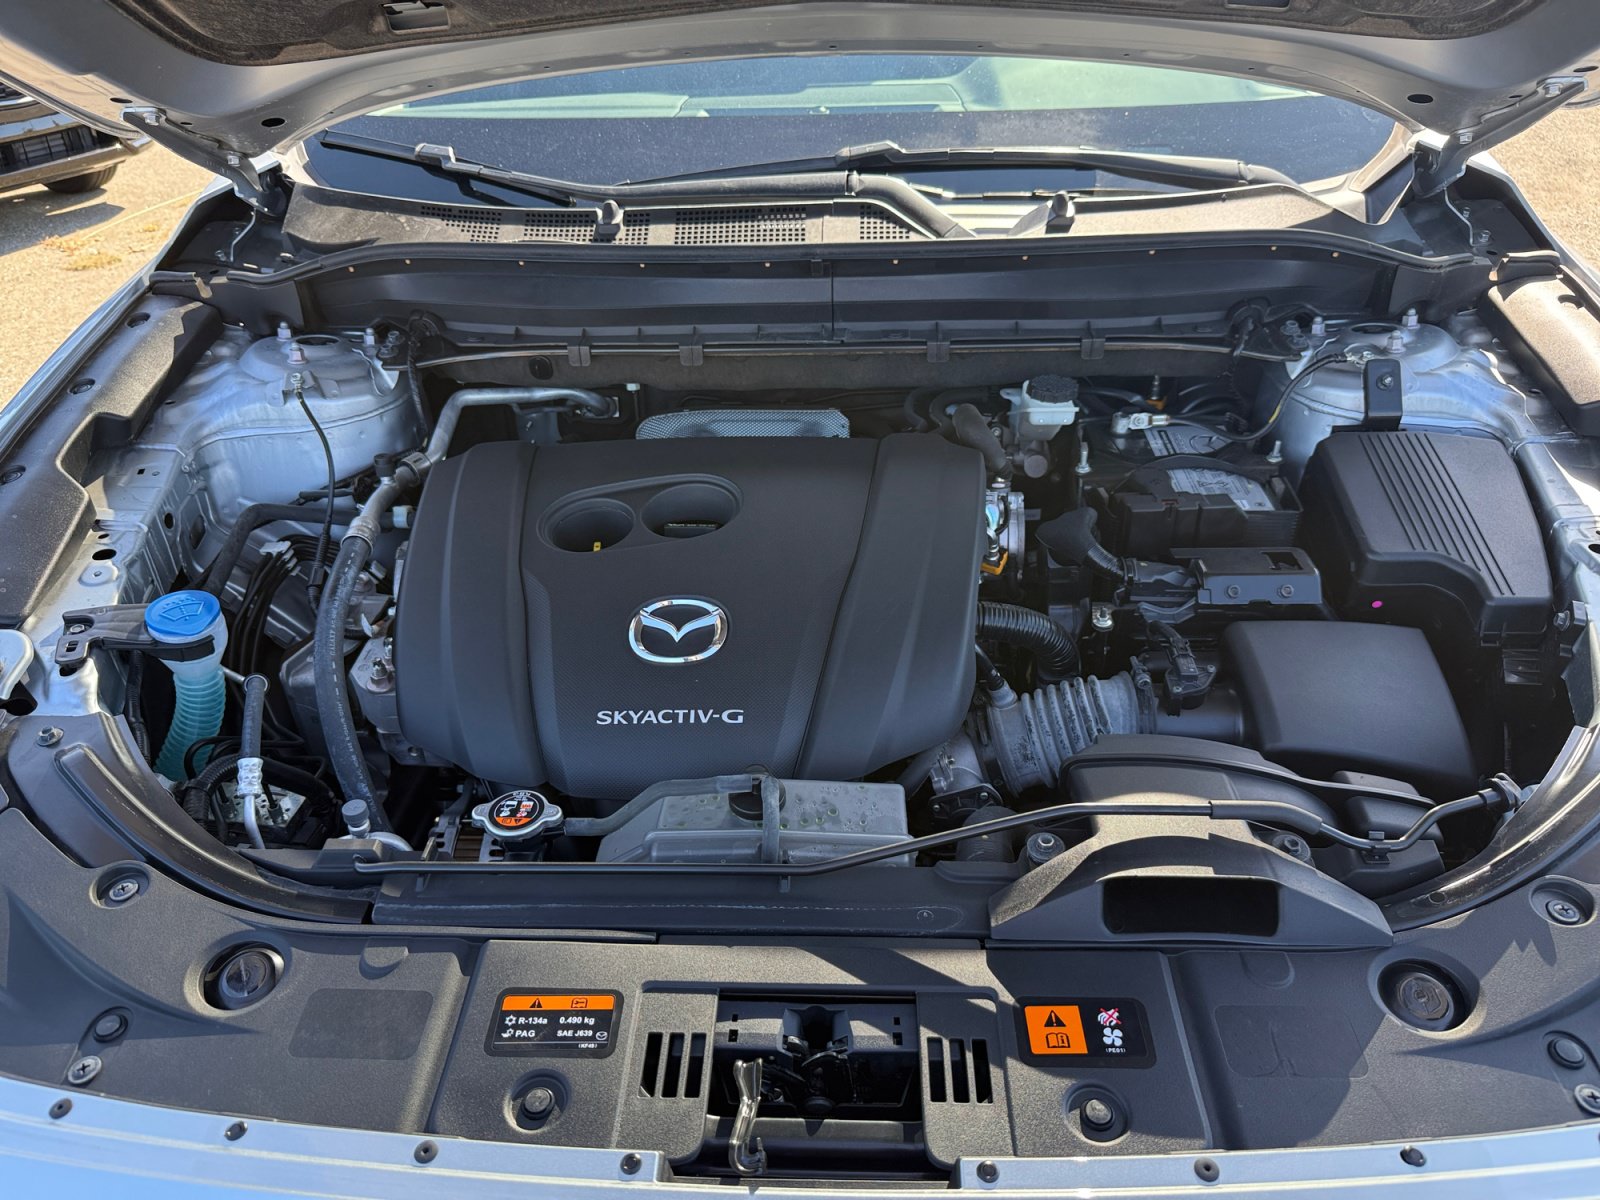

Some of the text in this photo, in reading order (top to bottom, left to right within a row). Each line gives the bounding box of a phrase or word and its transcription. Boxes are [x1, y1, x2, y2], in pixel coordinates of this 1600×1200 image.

[596, 709, 744, 725] SKYACTIV-G
[518, 1016, 596, 1026] R-134a 0.490 kg
[515, 1029, 593, 1038] PAG SAE J639
